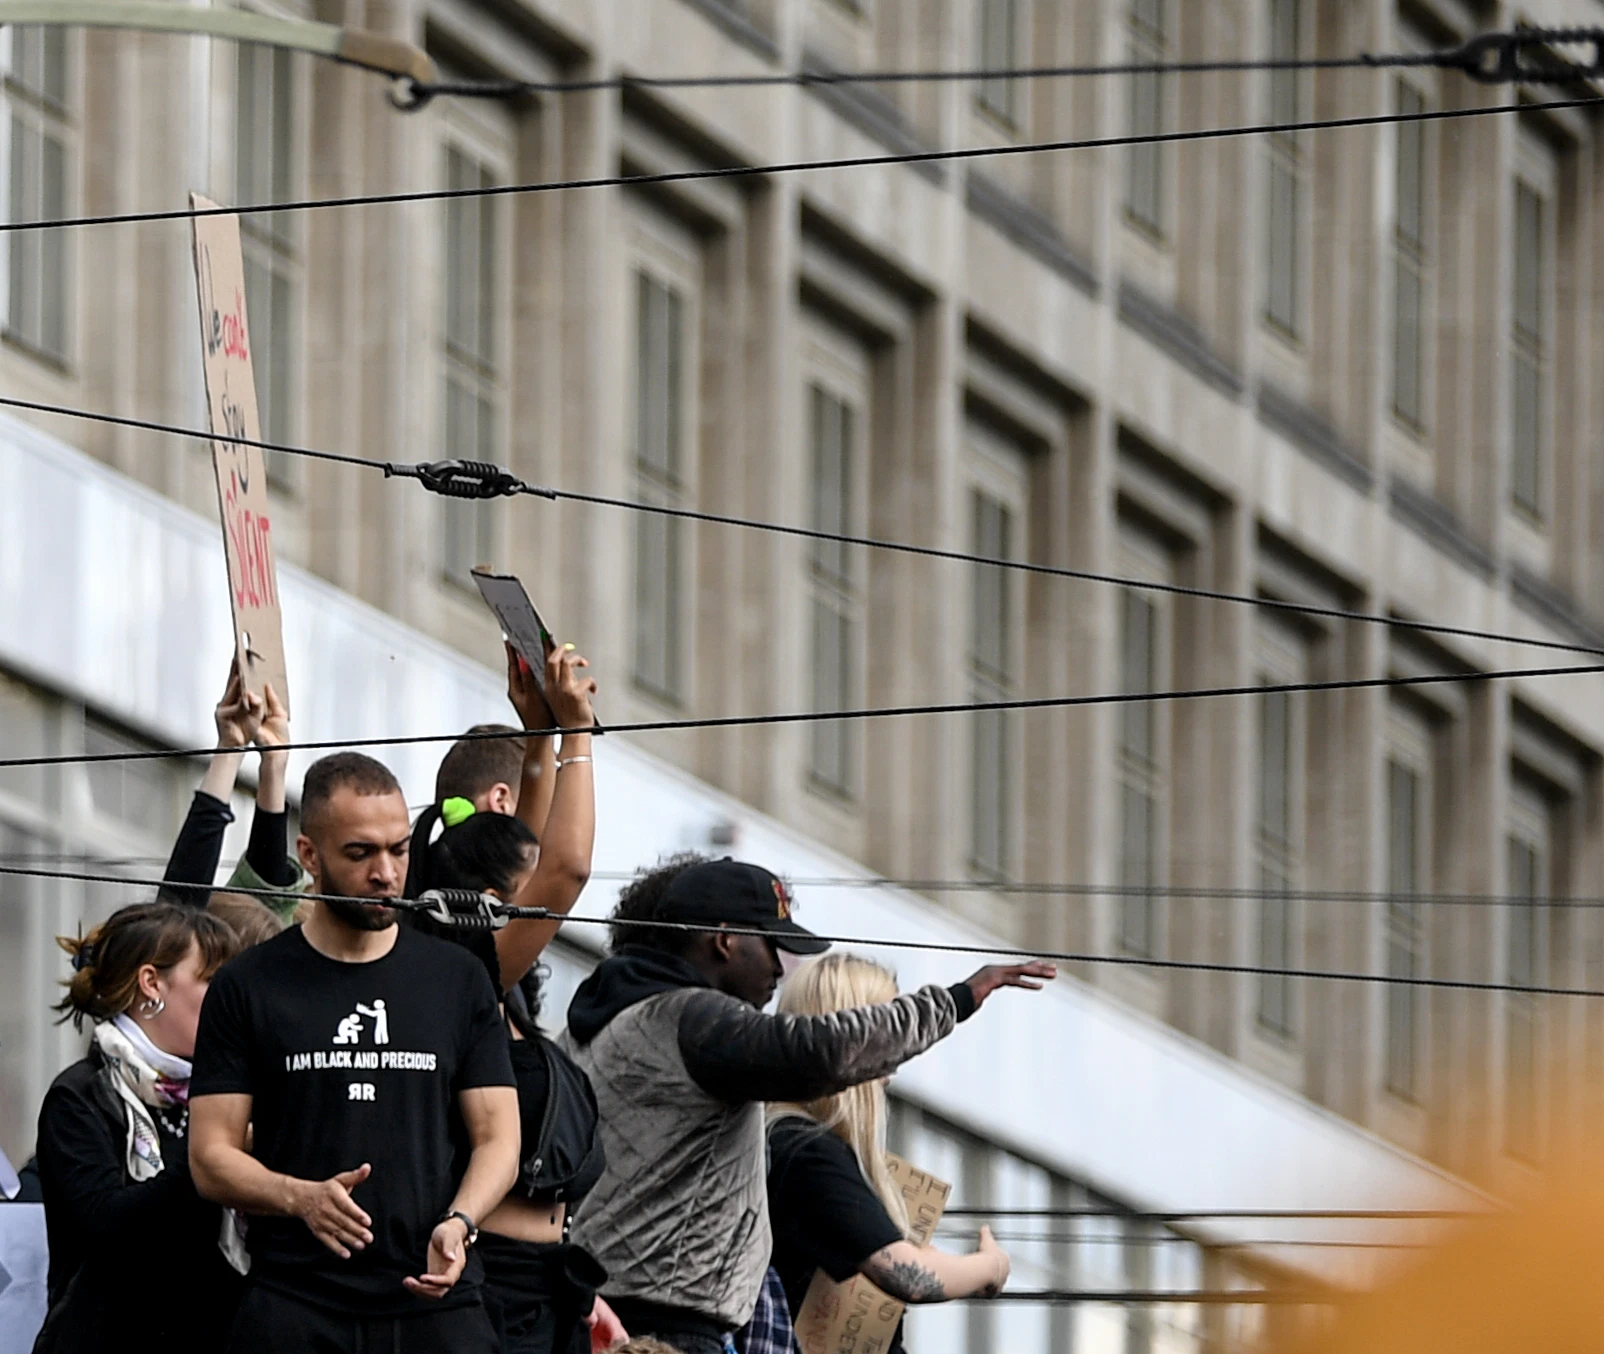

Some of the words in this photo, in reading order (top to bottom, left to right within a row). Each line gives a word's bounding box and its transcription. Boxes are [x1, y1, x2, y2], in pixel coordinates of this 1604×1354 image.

[292, 1052, 312, 1071] AM
[313, 1051, 353, 1069] BLACK
[354, 1051, 379, 1069] AND
[380, 1051, 437, 1071] PRECIOUS
